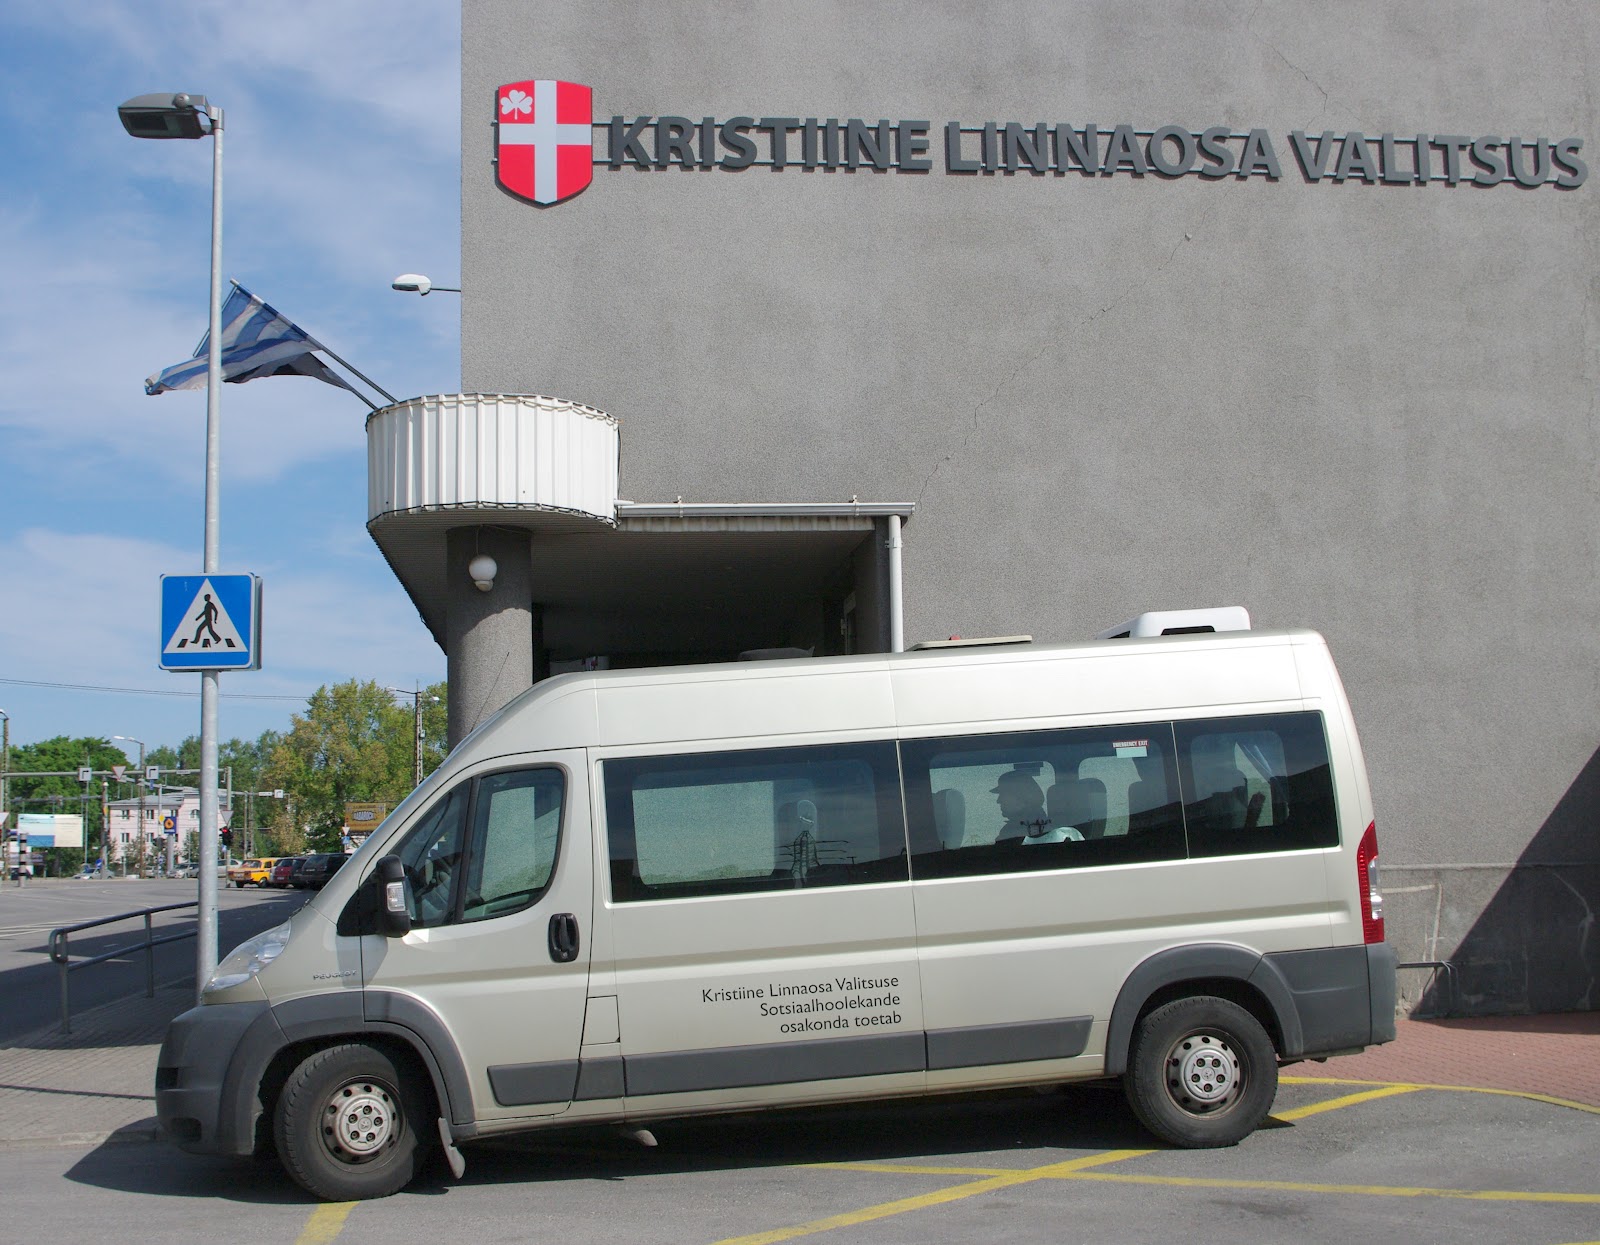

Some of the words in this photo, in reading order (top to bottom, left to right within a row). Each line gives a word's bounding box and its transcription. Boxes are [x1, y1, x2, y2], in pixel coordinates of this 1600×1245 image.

[610, 115, 933, 169] KRISTIINE
[947, 121, 1282, 178] LINNAOSA
[1291, 130, 1589, 188] VALITSUS
[313, 970, 357, 979] PEUGEOT
[702, 987, 764, 1002] Kristiine
[769, 982, 833, 997] Linnaosa
[835, 977, 899, 991] Valitsuse
[760, 993, 901, 1017] Sotsiaalhoolekande
[780, 1015, 849, 1034] osakonda
[854, 1011, 902, 1027] toetab
